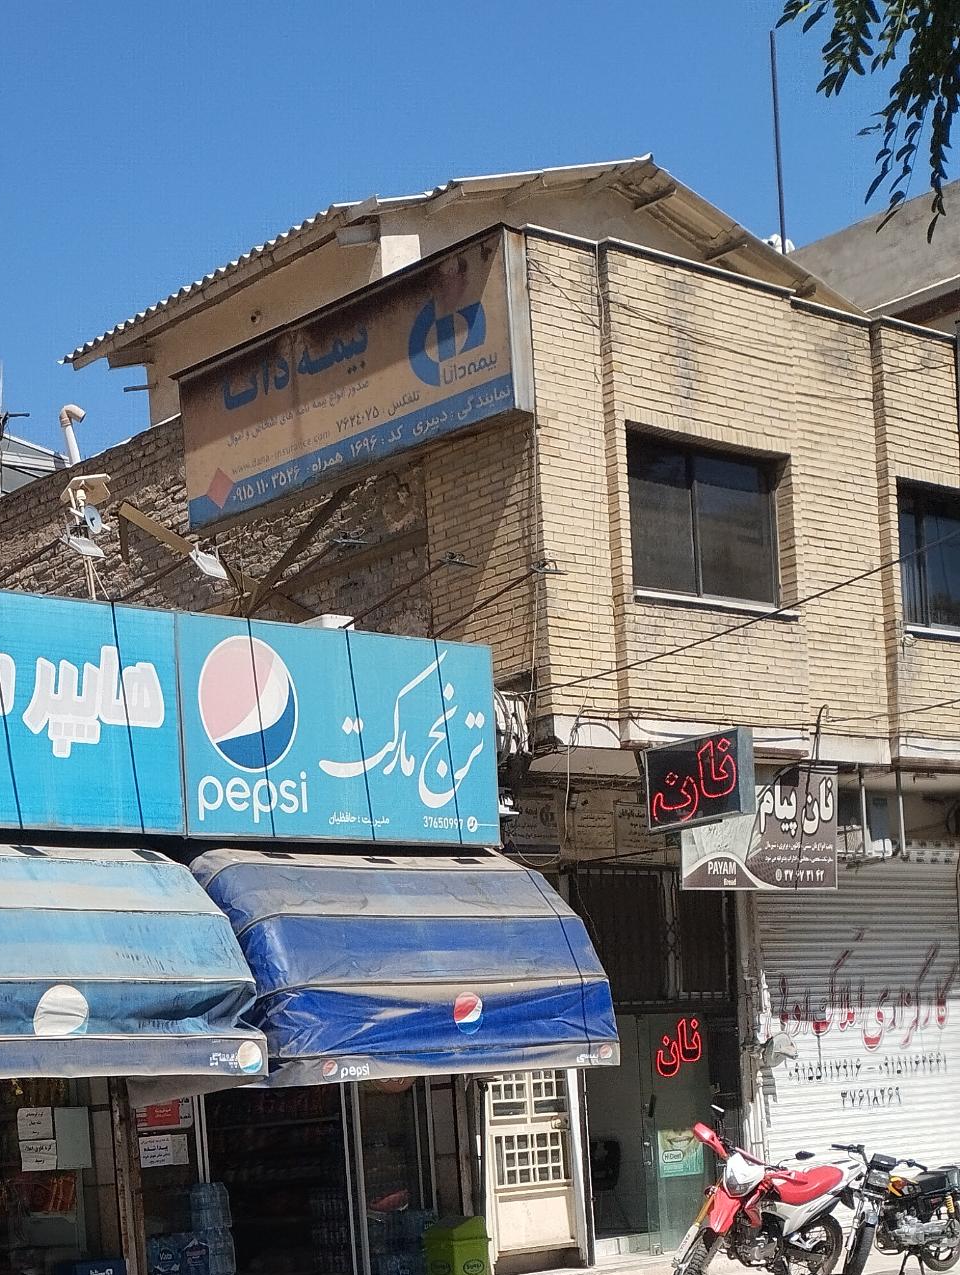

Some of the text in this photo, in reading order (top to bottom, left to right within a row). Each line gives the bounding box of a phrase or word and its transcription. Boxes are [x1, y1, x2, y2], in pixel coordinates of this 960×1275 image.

[23, 645, 165, 758] هایپر
[318, 649, 448, 779] مارکت
[197, 771, 308, 824] pepsi
[652, 737, 737, 823] نان
[759, 776, 835, 838] نان پیام
[707, 860, 737, 875] PAYAM
[340, 1062, 370, 1079] pepsi
[656, 1016, 702, 1078] نان
